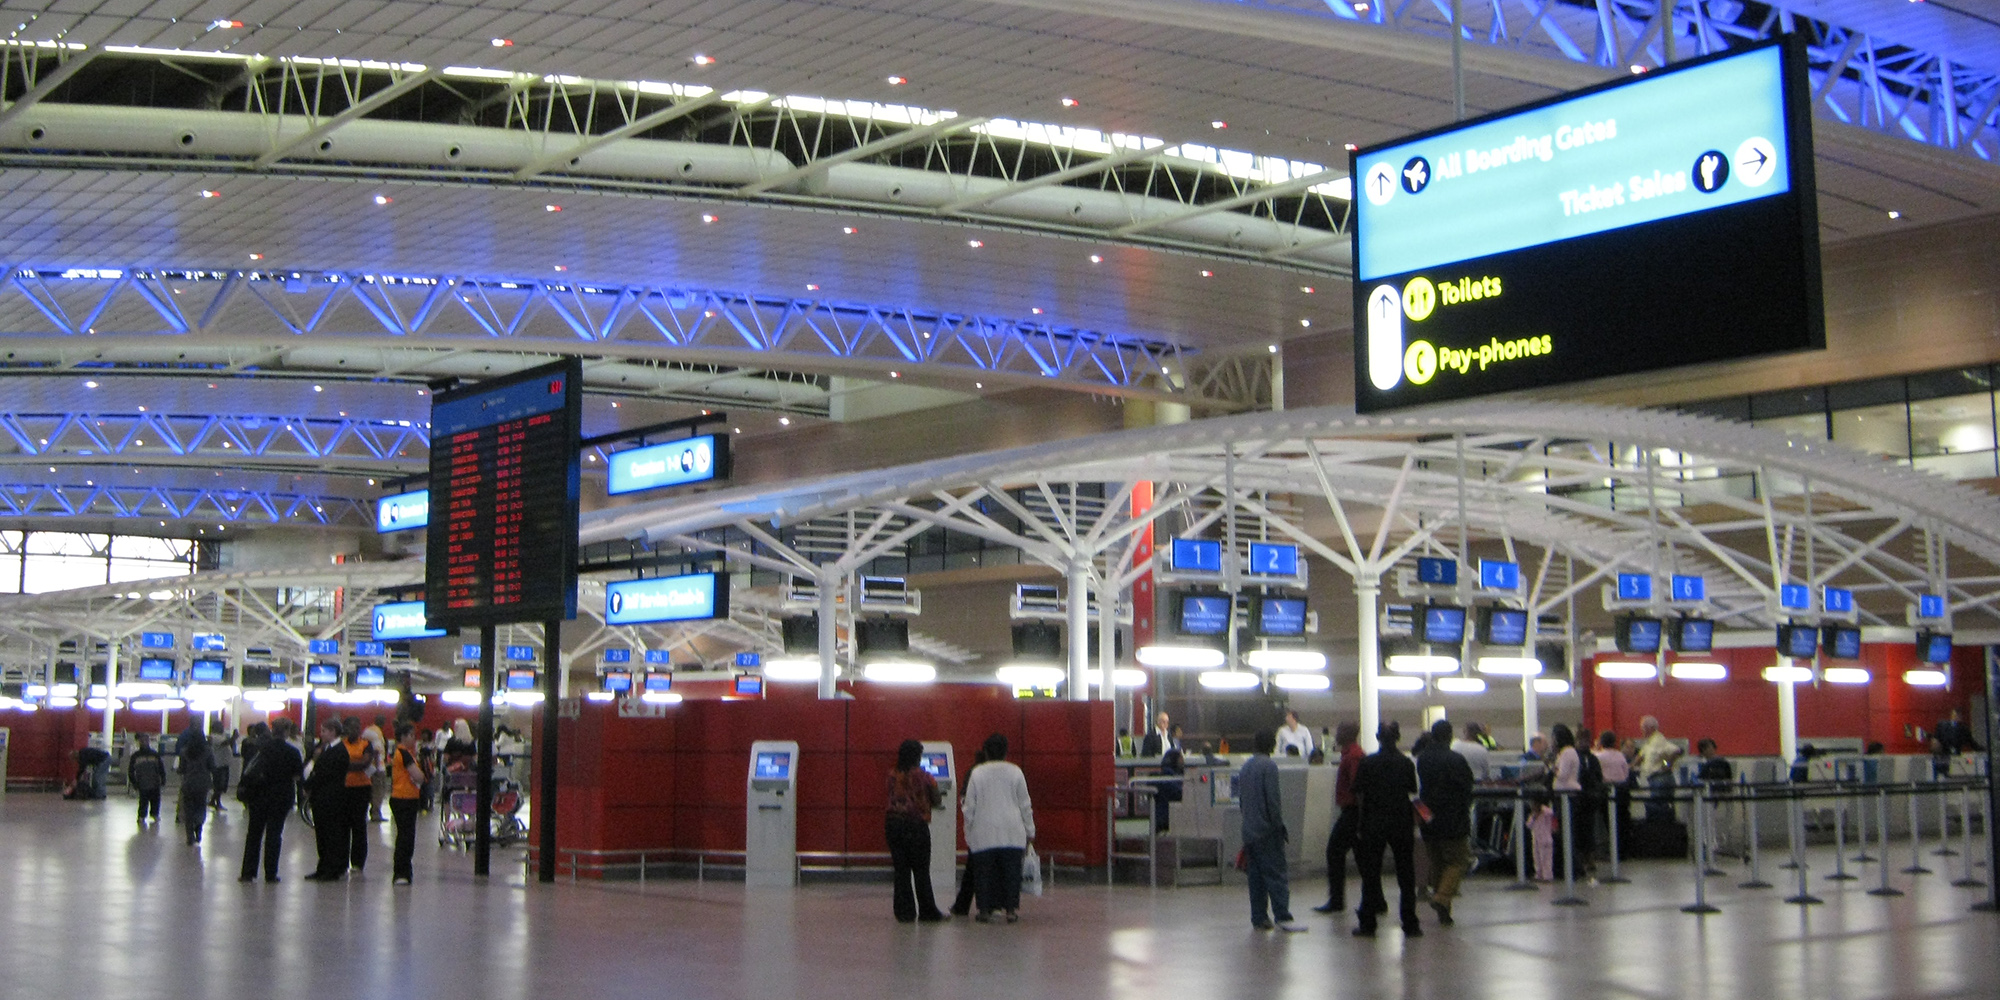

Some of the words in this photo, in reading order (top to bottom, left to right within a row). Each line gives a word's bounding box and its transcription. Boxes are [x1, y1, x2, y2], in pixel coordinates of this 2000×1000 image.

[1435, 152, 1462, 181] All
[1466, 134, 1554, 174] Boarding
[1555, 118, 1617, 150] Gates
[1559, 182, 1625, 216] Ticket
[1628, 169, 1687, 202] Sales
[1438, 275, 1502, 306] Toilets
[1439, 334, 1552, 374] Pay-phones
[1193, 544, 1201, 565] 1
[1268, 548, 1279, 569] 2
[1434, 562, 1443, 582] 3
[1495, 566, 1505, 585] 4
[1630, 578, 1639, 596] 5
[1683, 580, 1693, 598] 6
[1790, 587, 1798, 605] 7
[1833, 592, 1842, 609] 8
[153, 634, 164, 646] 19
[318, 641, 330, 653] 21
[364, 642, 377, 655] 22
[514, 647, 526, 659] 24
[652, 650, 663, 662] 26
[742, 653, 753, 666] 27
